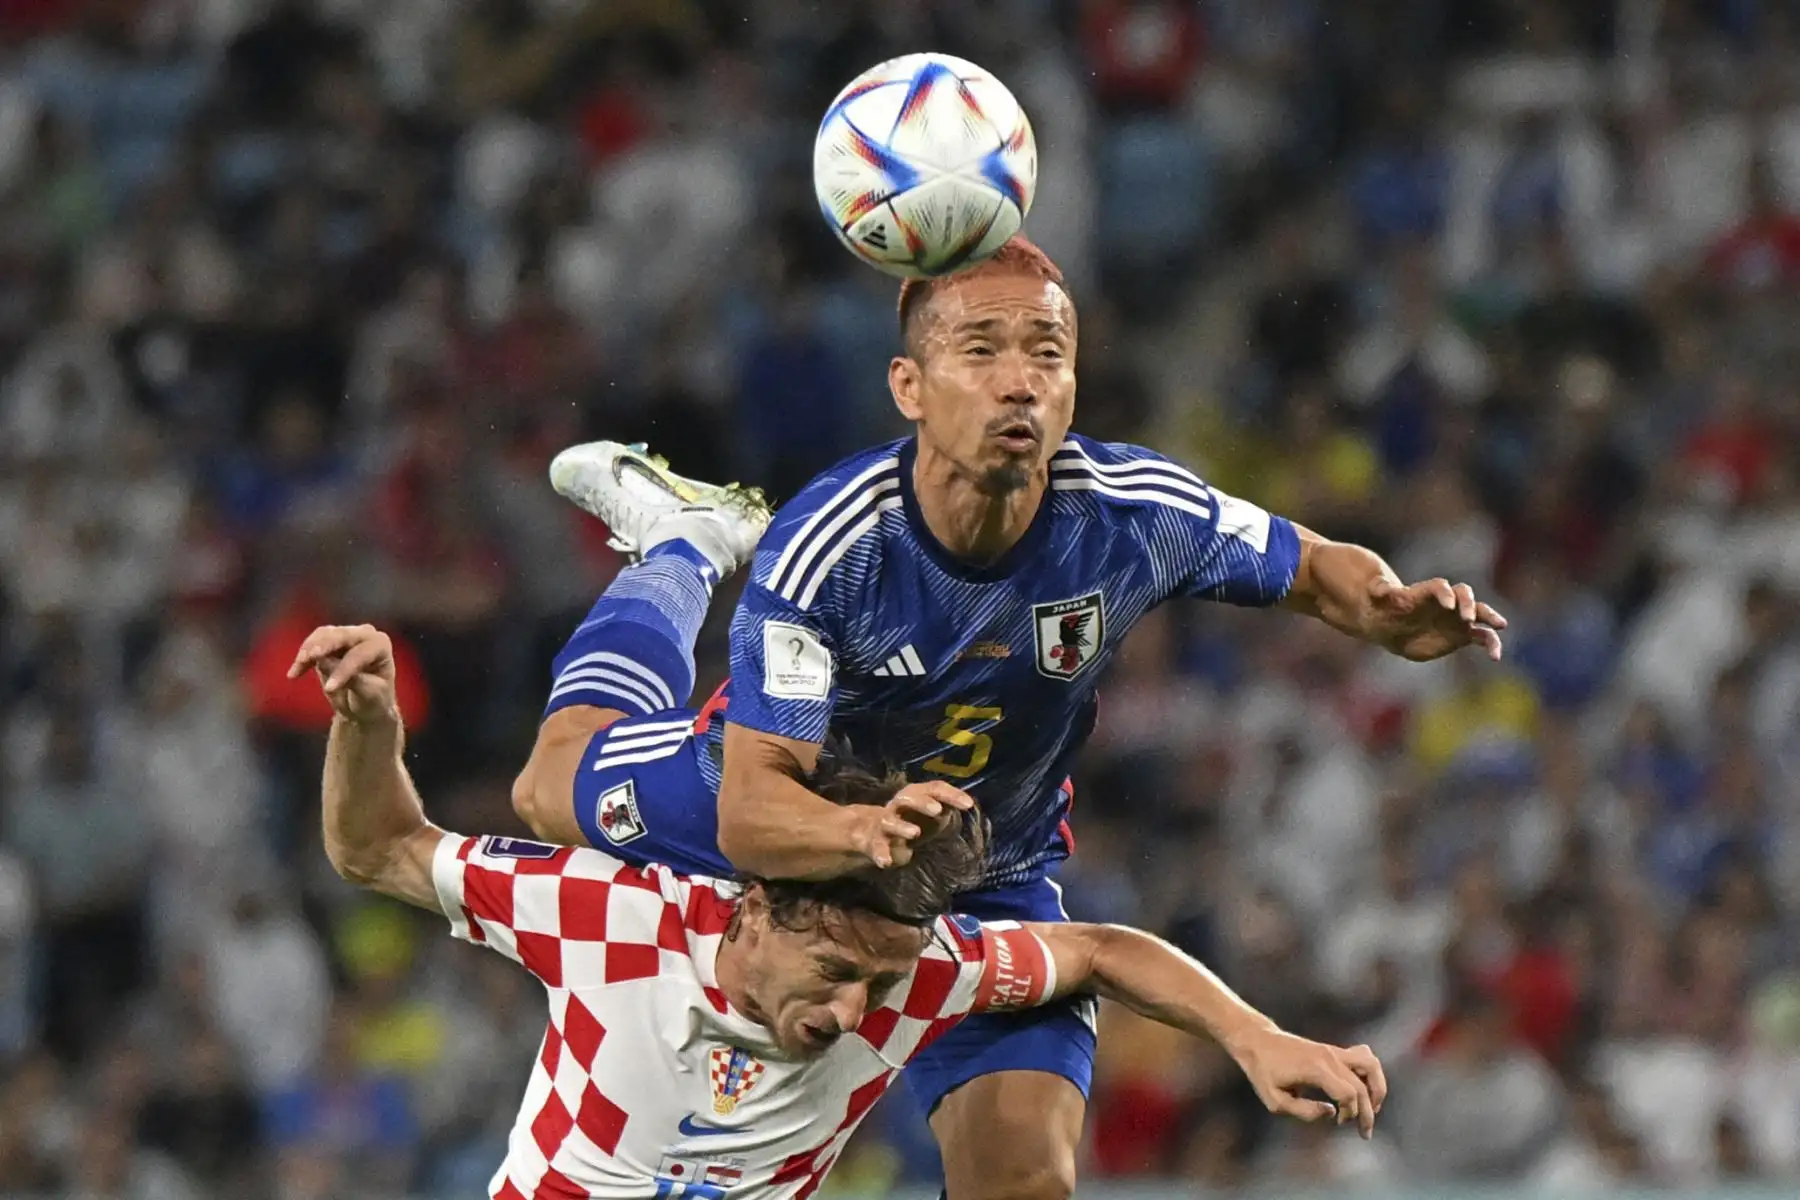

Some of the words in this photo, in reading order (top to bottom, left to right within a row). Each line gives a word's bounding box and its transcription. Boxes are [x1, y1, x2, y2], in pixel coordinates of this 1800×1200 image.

[1052, 600, 1087, 613] JAPAN
[923, 704, 1002, 777] 5
[989, 936, 1014, 1006] CATION
